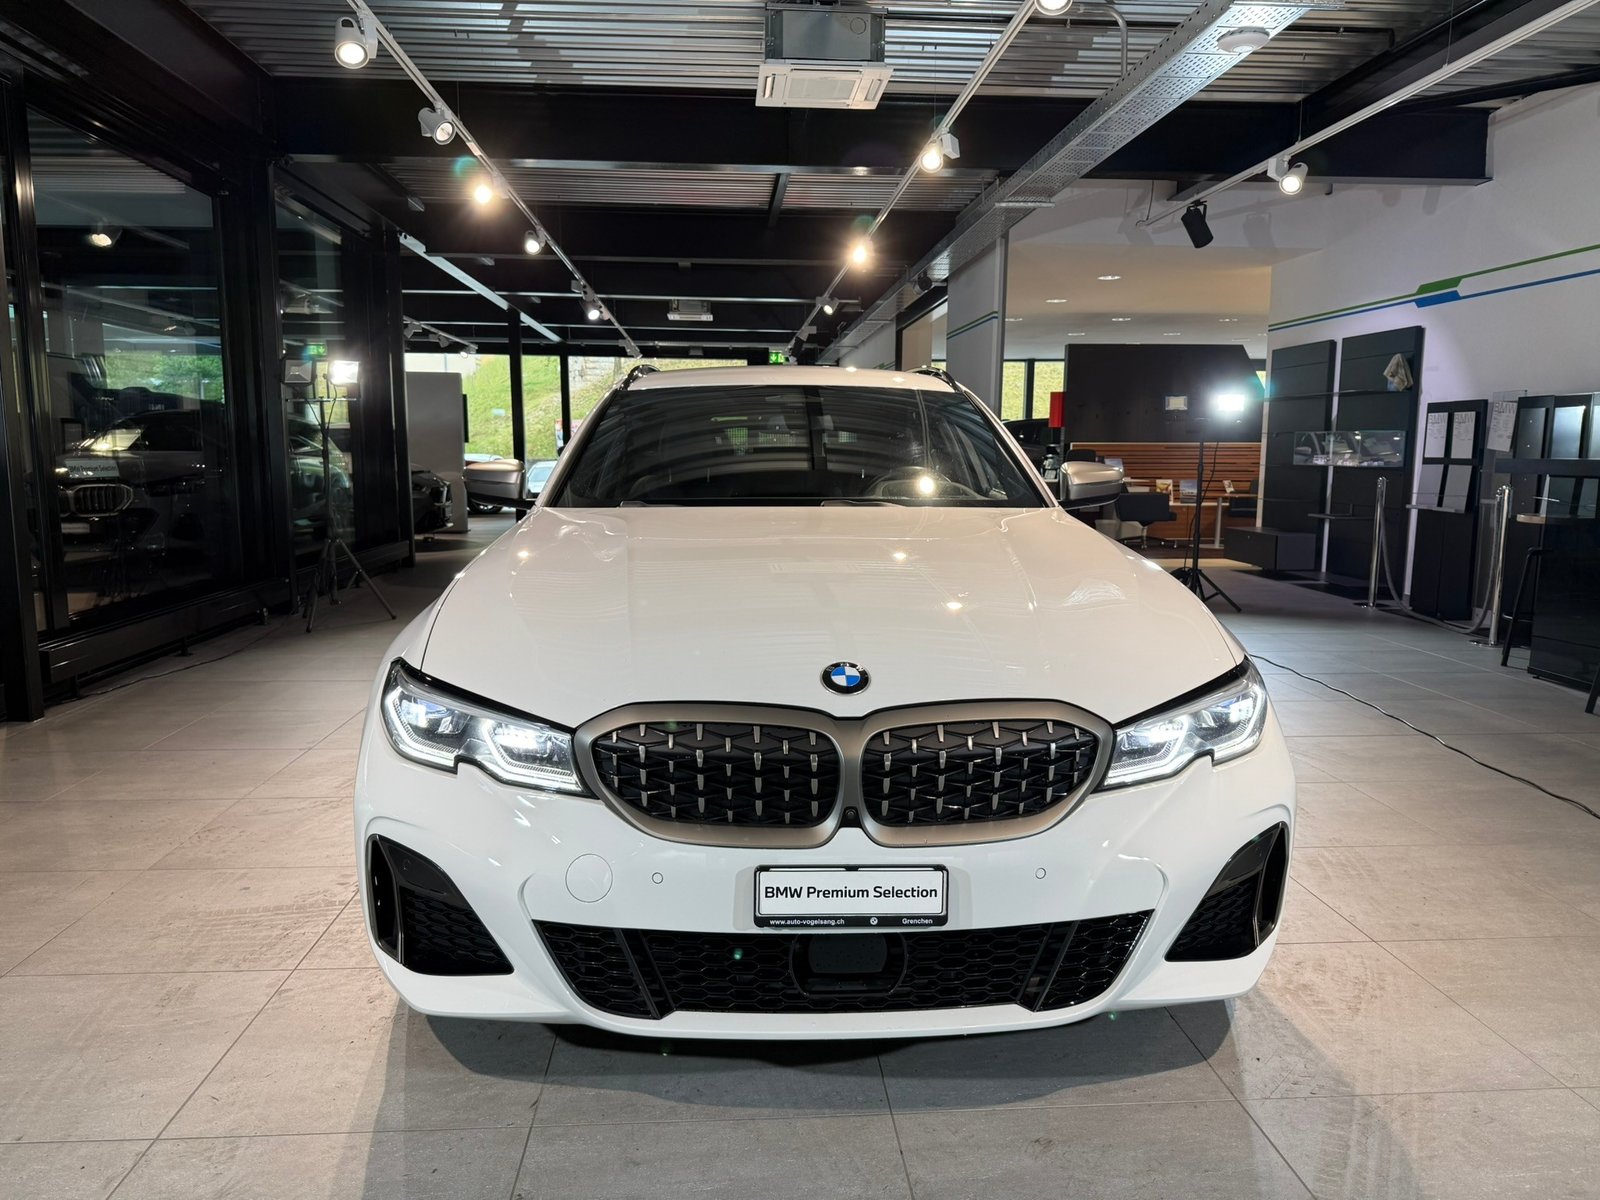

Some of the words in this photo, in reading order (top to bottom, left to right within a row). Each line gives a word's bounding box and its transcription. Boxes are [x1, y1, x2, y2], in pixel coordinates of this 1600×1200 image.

[764, 886, 803, 899] BMW
[806, 886, 870, 898] Premium
[872, 885, 938, 899] Selection
[901, 917, 933, 925] Grenchen
